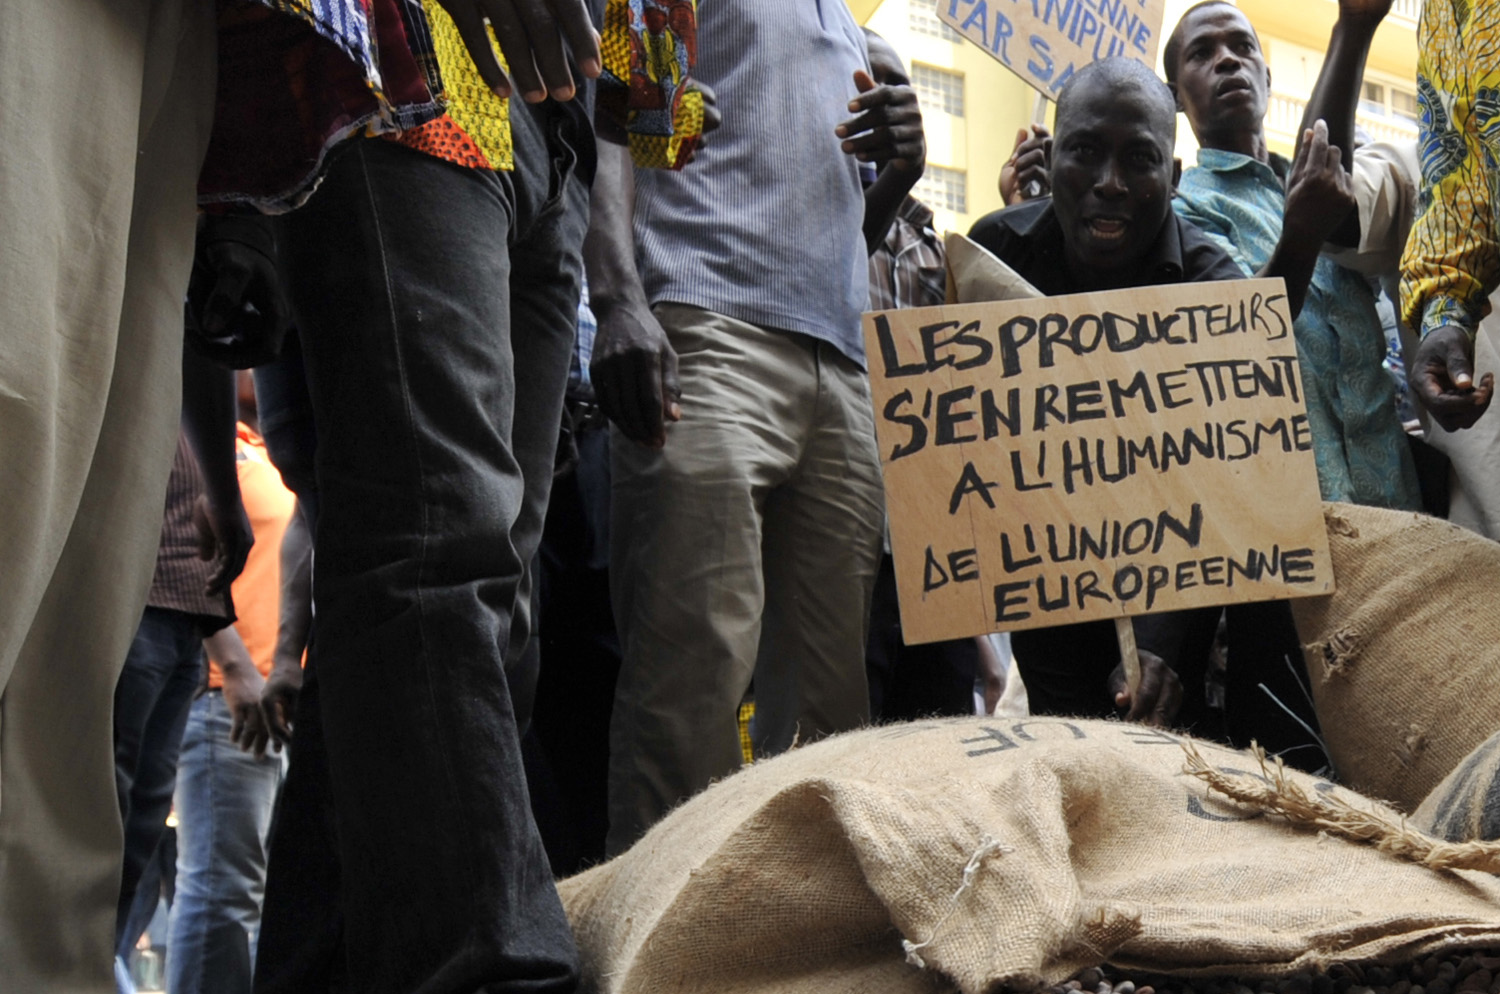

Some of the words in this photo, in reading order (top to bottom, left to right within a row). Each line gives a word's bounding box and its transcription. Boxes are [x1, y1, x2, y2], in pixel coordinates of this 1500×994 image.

[872, 313, 994, 379] LES
[998, 292, 1288, 379] PRODUCTEURS
[883, 385, 1021, 462] S'EN
[1033, 355, 1300, 432] REMETTENT
[948, 460, 999, 516] A
[1009, 413, 1313, 496] L'HUMANISME
[922, 545, 980, 594] DE
[1000, 502, 1204, 574] L'UNION
[993, 544, 1316, 624] EUROPEENNE
